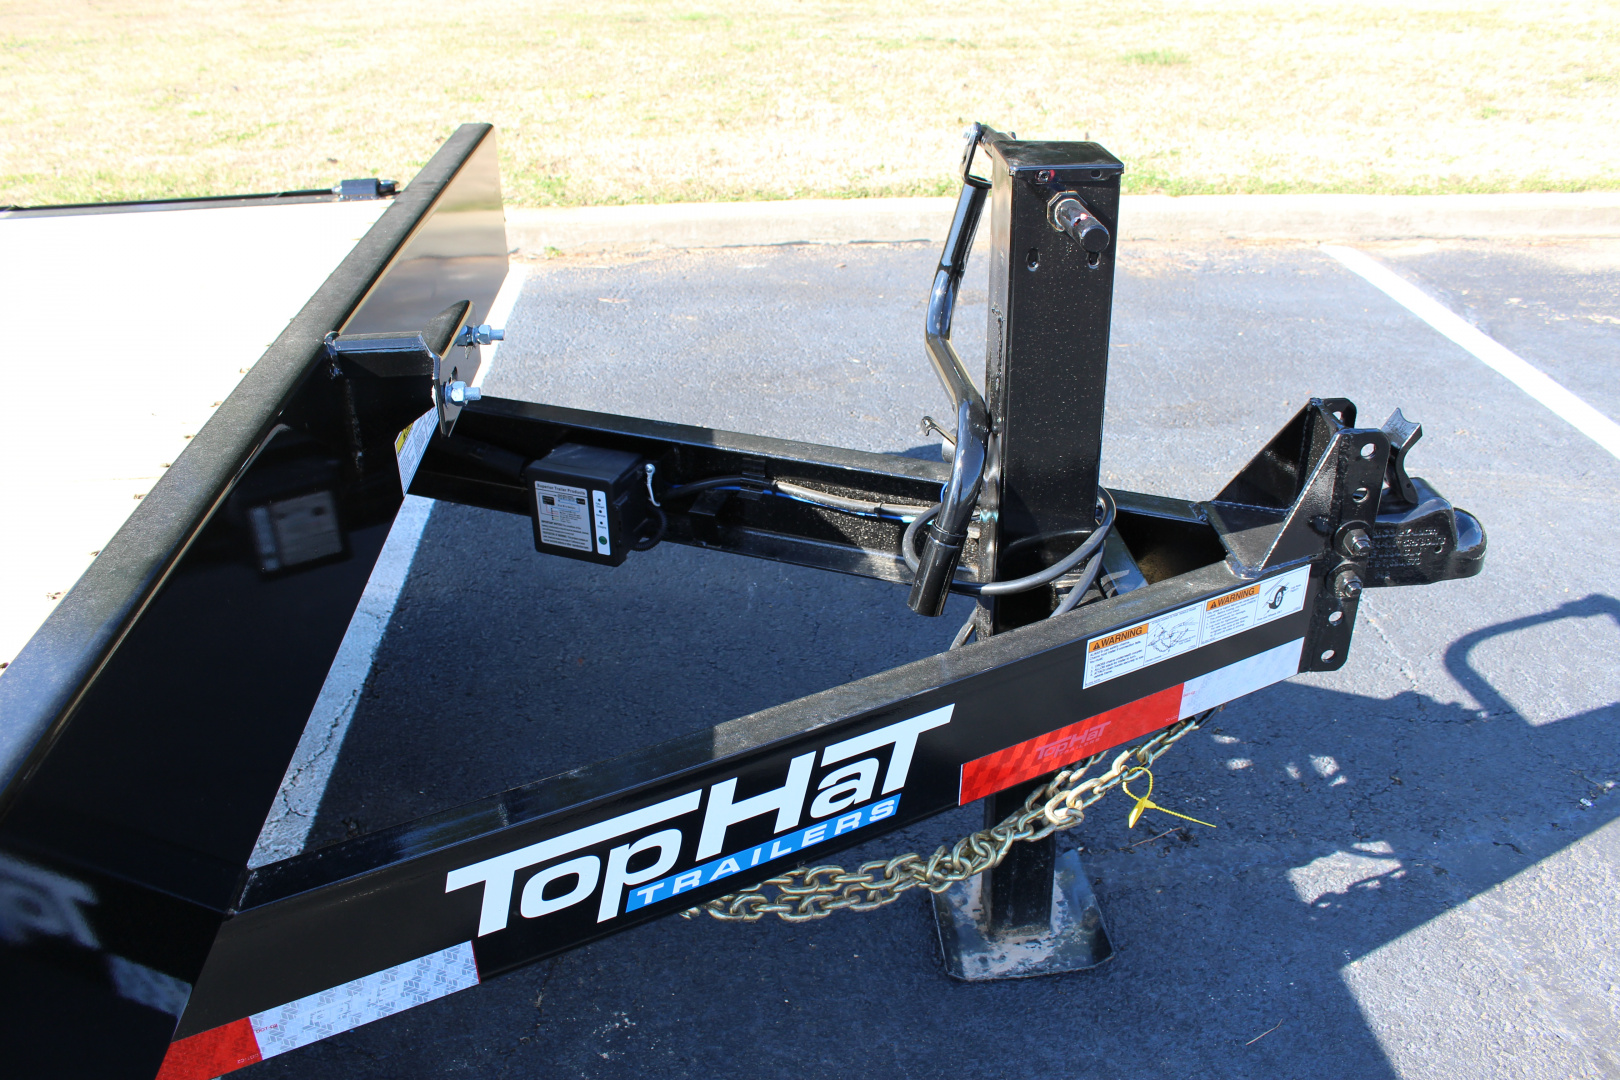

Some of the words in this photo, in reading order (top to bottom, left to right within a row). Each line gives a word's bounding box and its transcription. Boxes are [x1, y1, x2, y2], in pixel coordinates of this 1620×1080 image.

[1218, 587, 1255, 606] WARNING
[1101, 626, 1143, 648] WARNING
[635, 800, 897, 906] TRAILERS
